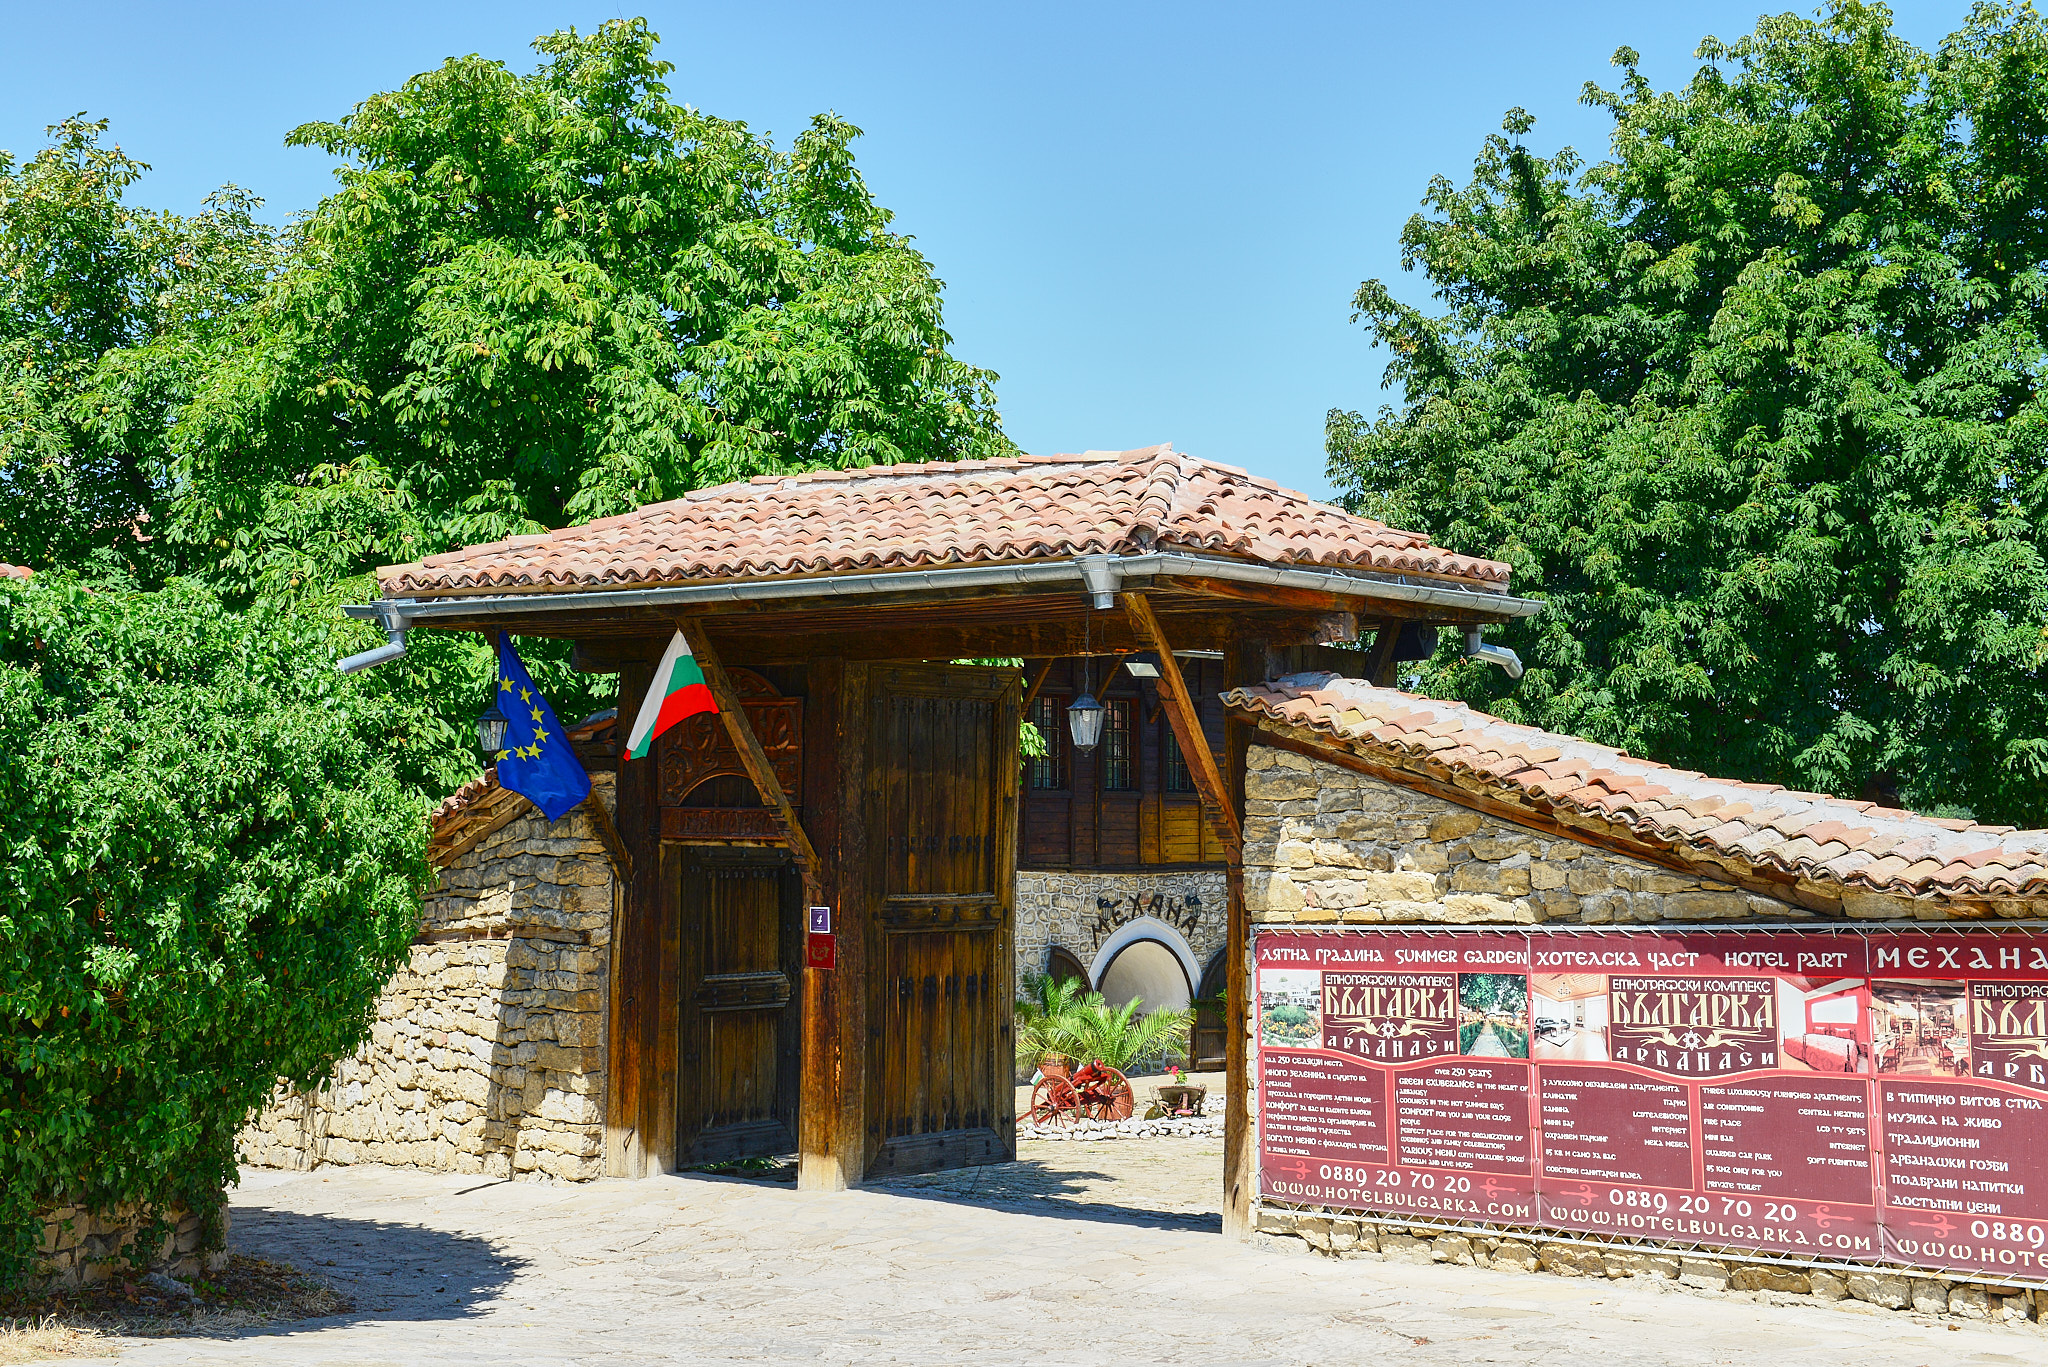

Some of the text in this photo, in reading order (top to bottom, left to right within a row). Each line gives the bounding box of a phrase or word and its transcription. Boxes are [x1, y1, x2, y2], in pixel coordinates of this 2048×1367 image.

[816, 914, 823, 925] 4
[1092, 893, 1199, 949] МЕХАНА
[1262, 948, 1310, 961] ЛЯТНА
[1316, 949, 1384, 965] ГРАДИНА
[1395, 949, 1457, 964] SUMMER
[1536, 952, 1641, 966] ХОТЕЛСКА
[1648, 953, 1699, 971] ЧАСТ
[1725, 952, 1789, 966] HOTEL
[1878, 947, 2048, 969] МЕХАНА
[1326, 975, 1452, 987] ЕТНОГРАФСКИ КОМПЛЕКС
[1613, 979, 1770, 993] ЕТНОГРАФСКИ КОМПЛЕКС
[1328, 1036, 1454, 1057] АРБАНАСИ
[1278, 1056, 1290, 1064] 250
[1616, 1047, 1774, 1071] АРБАНАСИ
[1452, 1068, 1465, 1077] 250
[1887, 1092, 2042, 1109] В ТИПИЧНО БИТОВ СТИЛ
[1888, 1113, 2002, 1128] МУЗИКА НА ЖИВО
[1888, 1133, 1980, 1148] ТРАДИЦИОННИ
[1890, 1154, 2008, 1172] АРБАНАШКИ ГОЗБИ
[1320, 1165, 1470, 1193] 0889 20 70 20
[1891, 1174, 2024, 1194] ПОДБРАНИ НАПИТКИ
[1273, 1180, 1529, 1217] WWW.HOTELBULGARKA.COM
[1609, 1189, 1796, 1222] 0889 20 70 20
[1892, 1195, 2001, 1213] ДОСТЪПНИ ЦЕНИ
[1550, 1206, 1870, 1251] WWW.HOTELBULGARKA.COM
[1971, 1221, 2044, 1249] 0889
